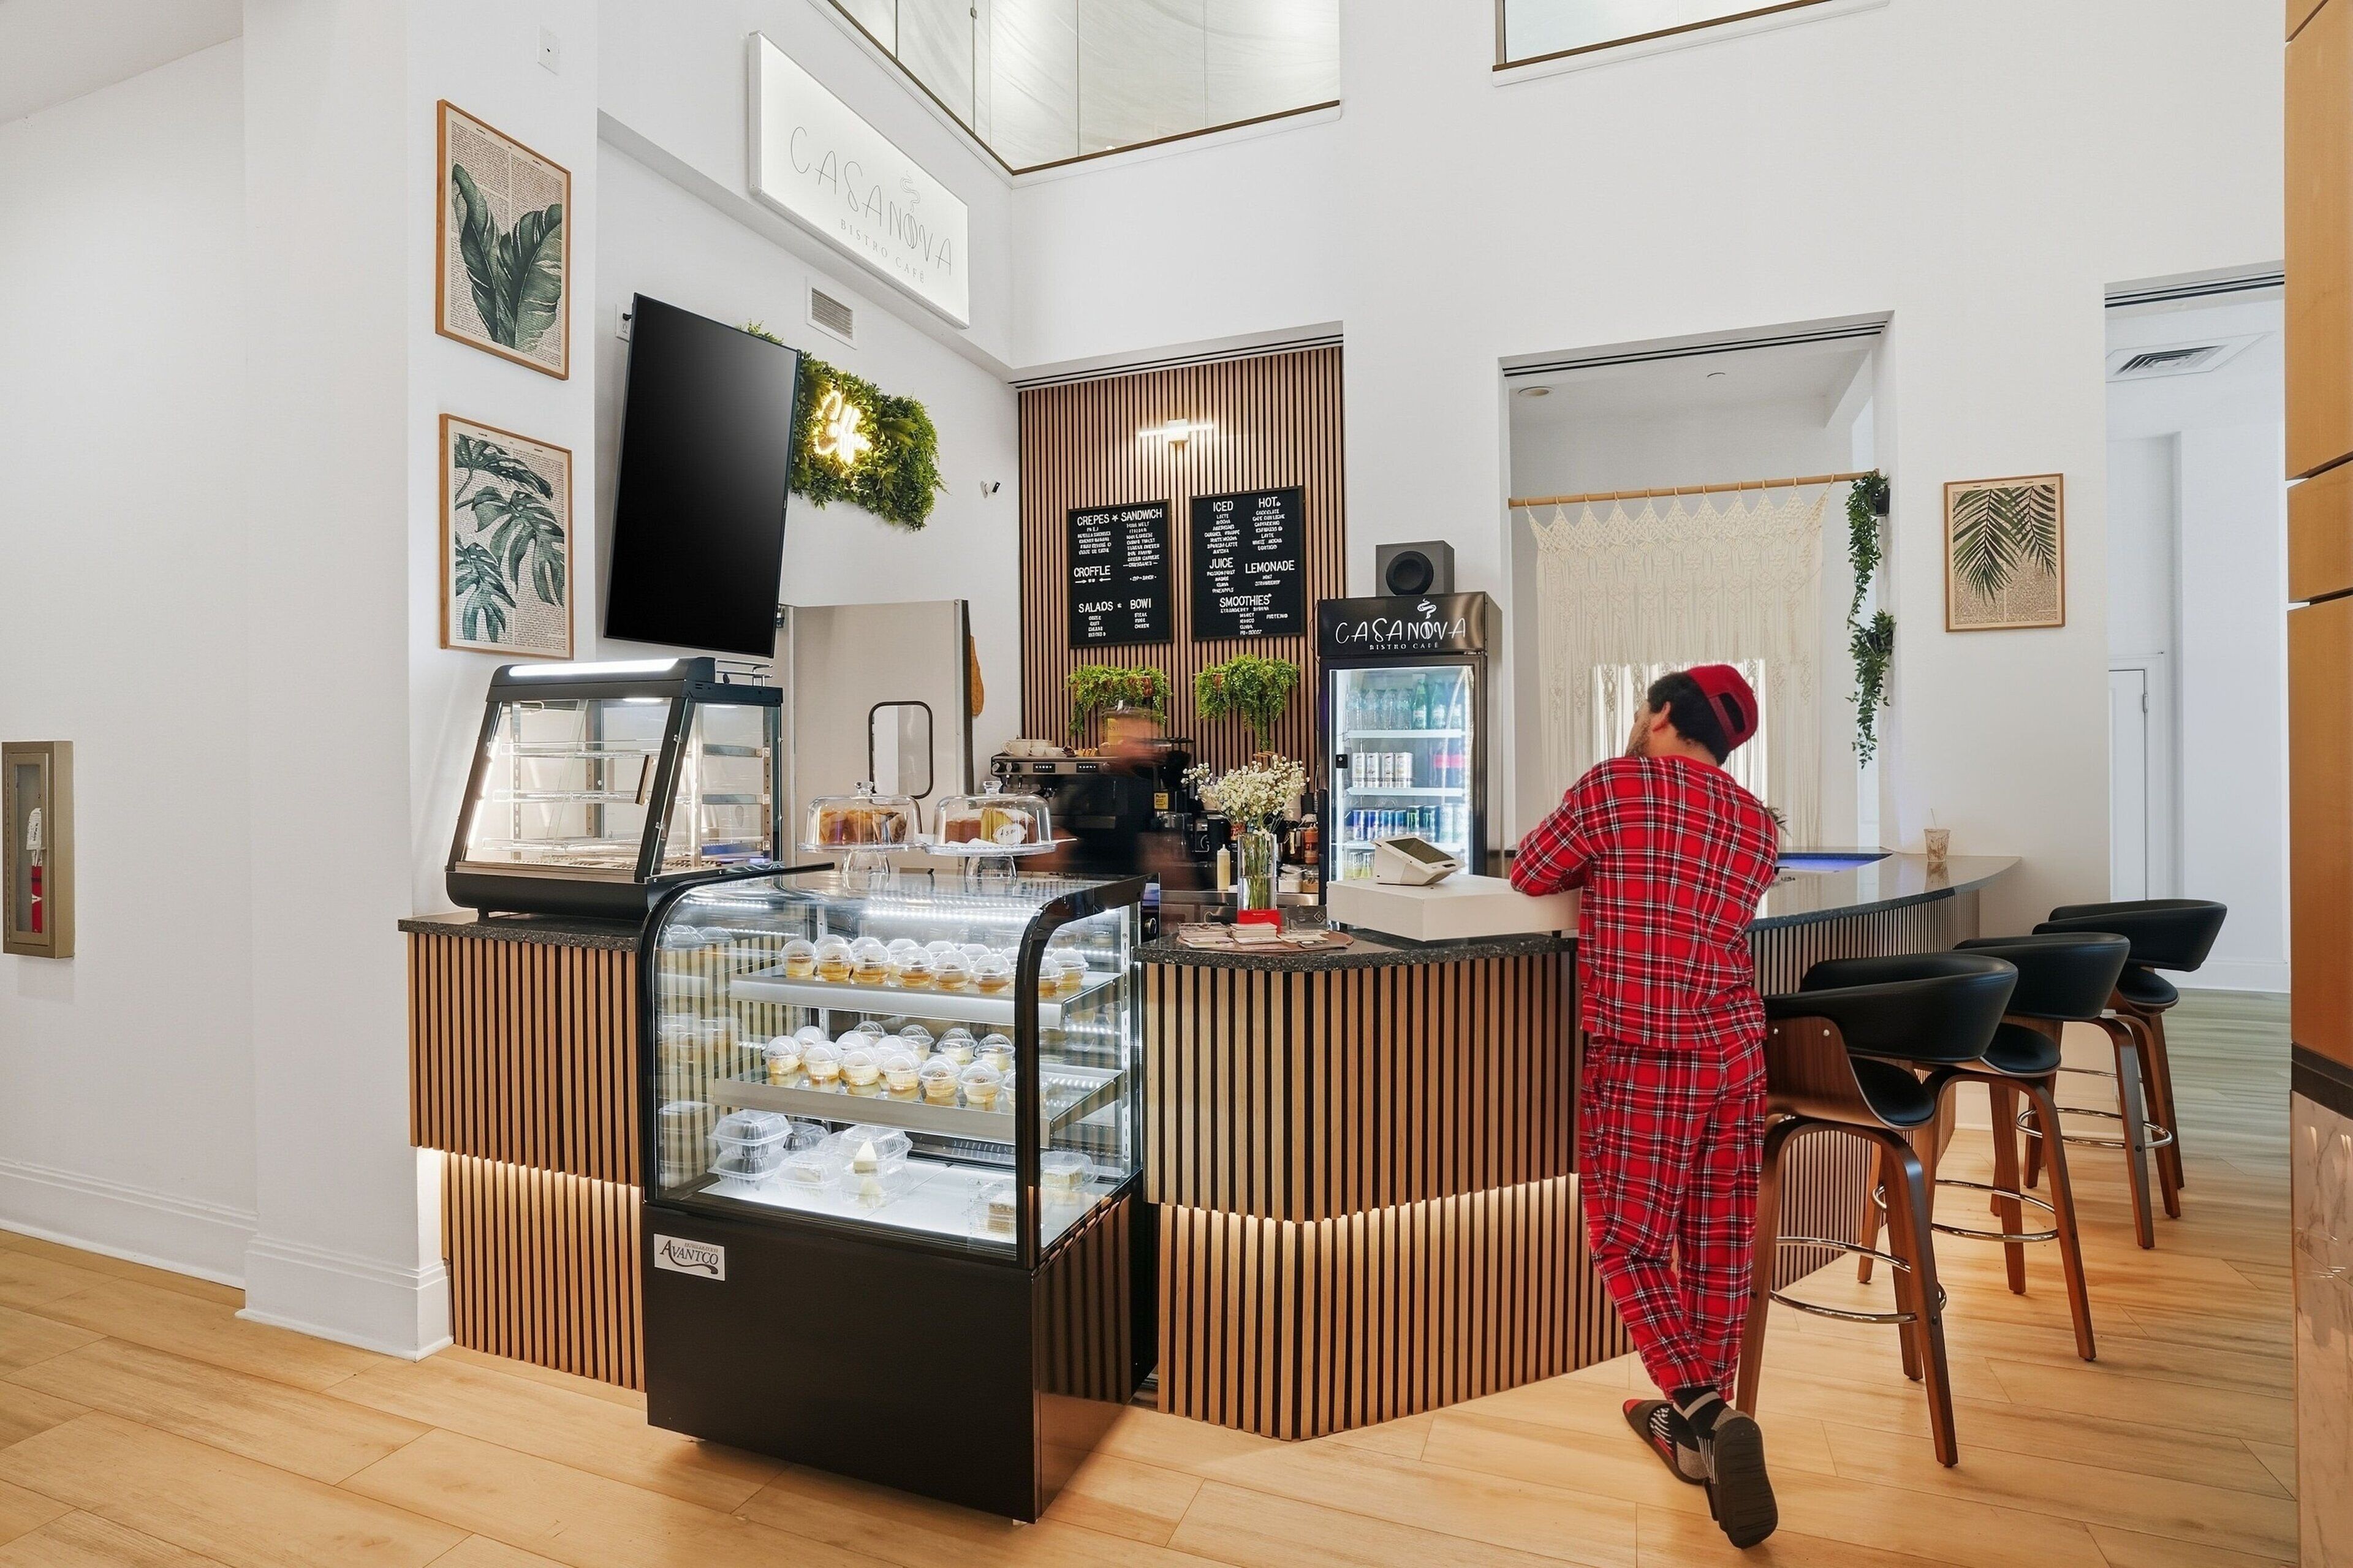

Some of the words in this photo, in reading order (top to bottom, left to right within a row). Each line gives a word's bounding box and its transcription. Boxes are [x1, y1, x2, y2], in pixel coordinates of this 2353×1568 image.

[790, 126, 952, 276] CASANOVA
[841, 219, 888, 258] BISTRO
[1213, 500, 1233, 512] ICED
[1259, 496, 1278, 508] HOT
[1077, 513, 1110, 526] CREPES
[1121, 509, 1162, 521] SANDWICH
[1209, 557, 1233, 569] JUICE
[1245, 559, 1295, 574] LEMONADE
[1074, 566, 1111, 577] CROFFLE
[1078, 601, 1113, 613] SALADS
[1219, 594, 1270, 607] SMOOTHIES
[1335, 618, 1466, 643] CASANOVA
